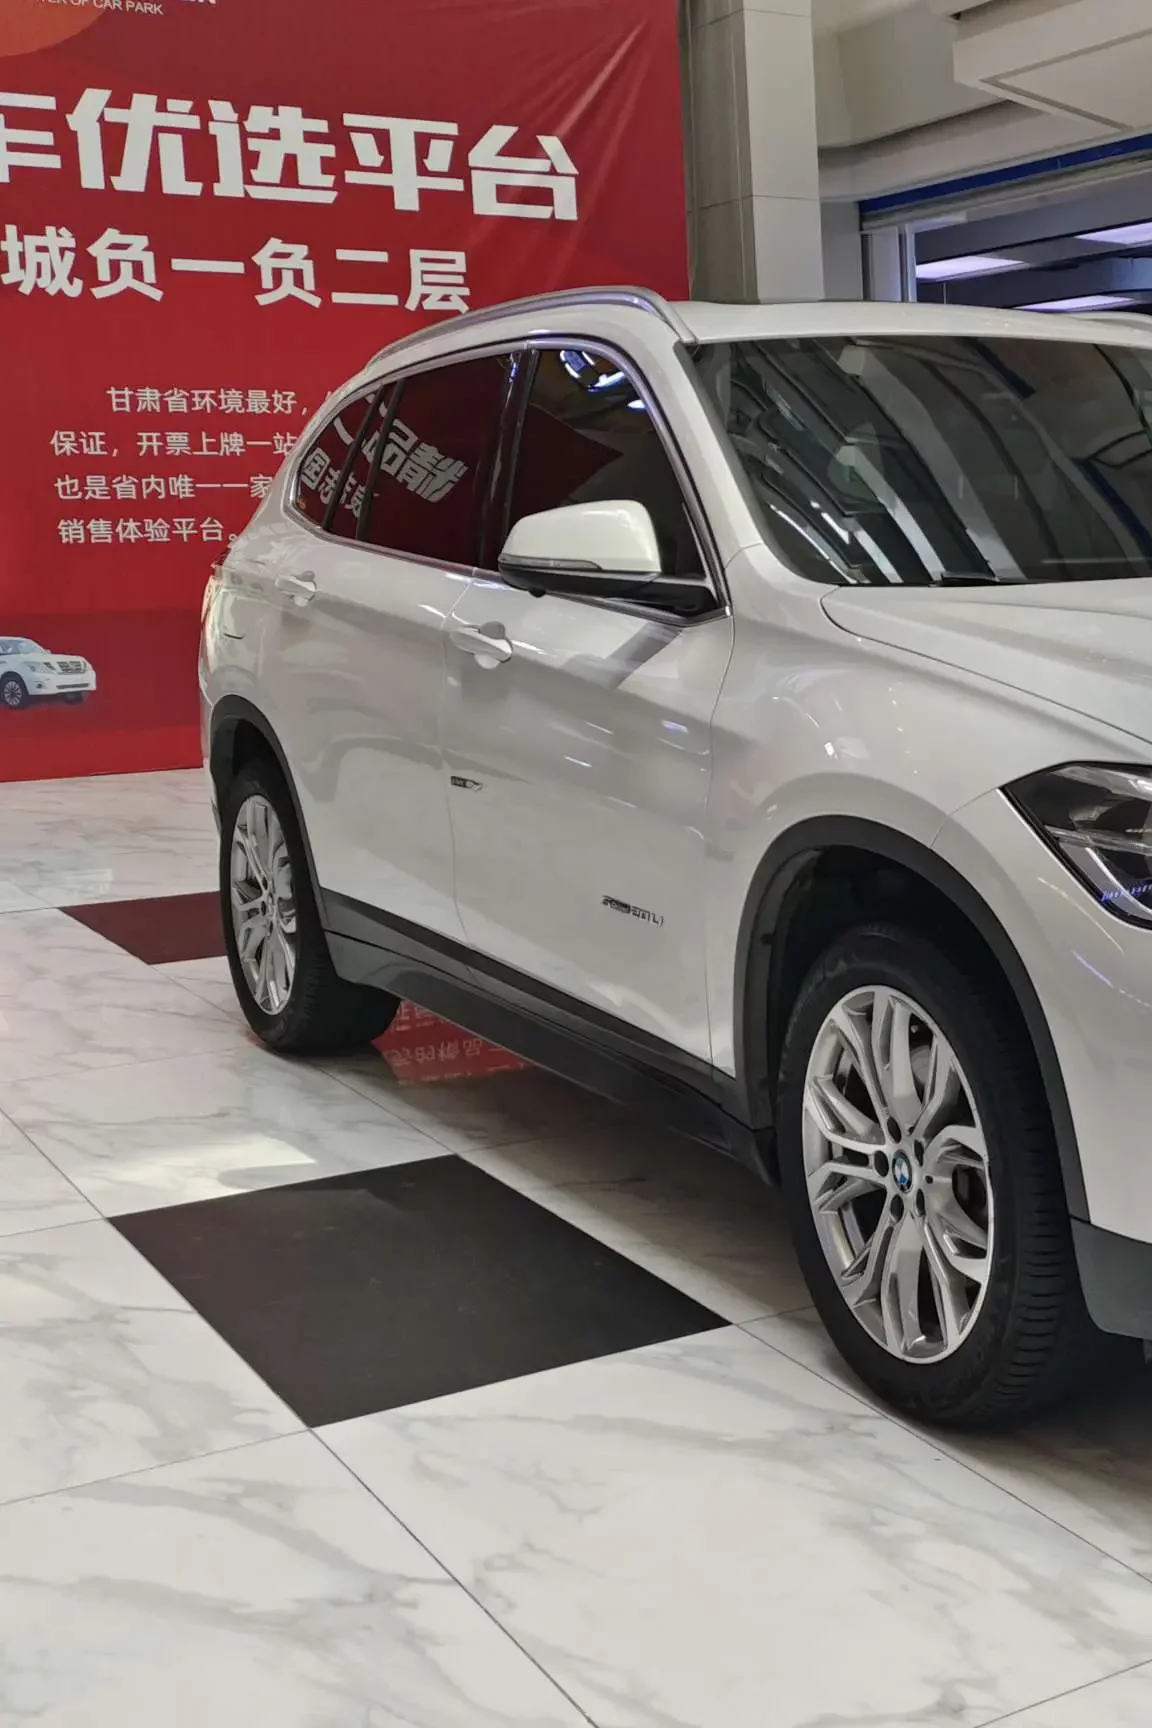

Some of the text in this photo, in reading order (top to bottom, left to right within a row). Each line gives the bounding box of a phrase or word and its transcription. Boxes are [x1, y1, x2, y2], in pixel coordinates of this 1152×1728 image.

[126, 1, 164, 16] PARK
[0, 223, 471, 314] 城负一负二层
[54, 473, 274, 500] 也是省内唯一一家
